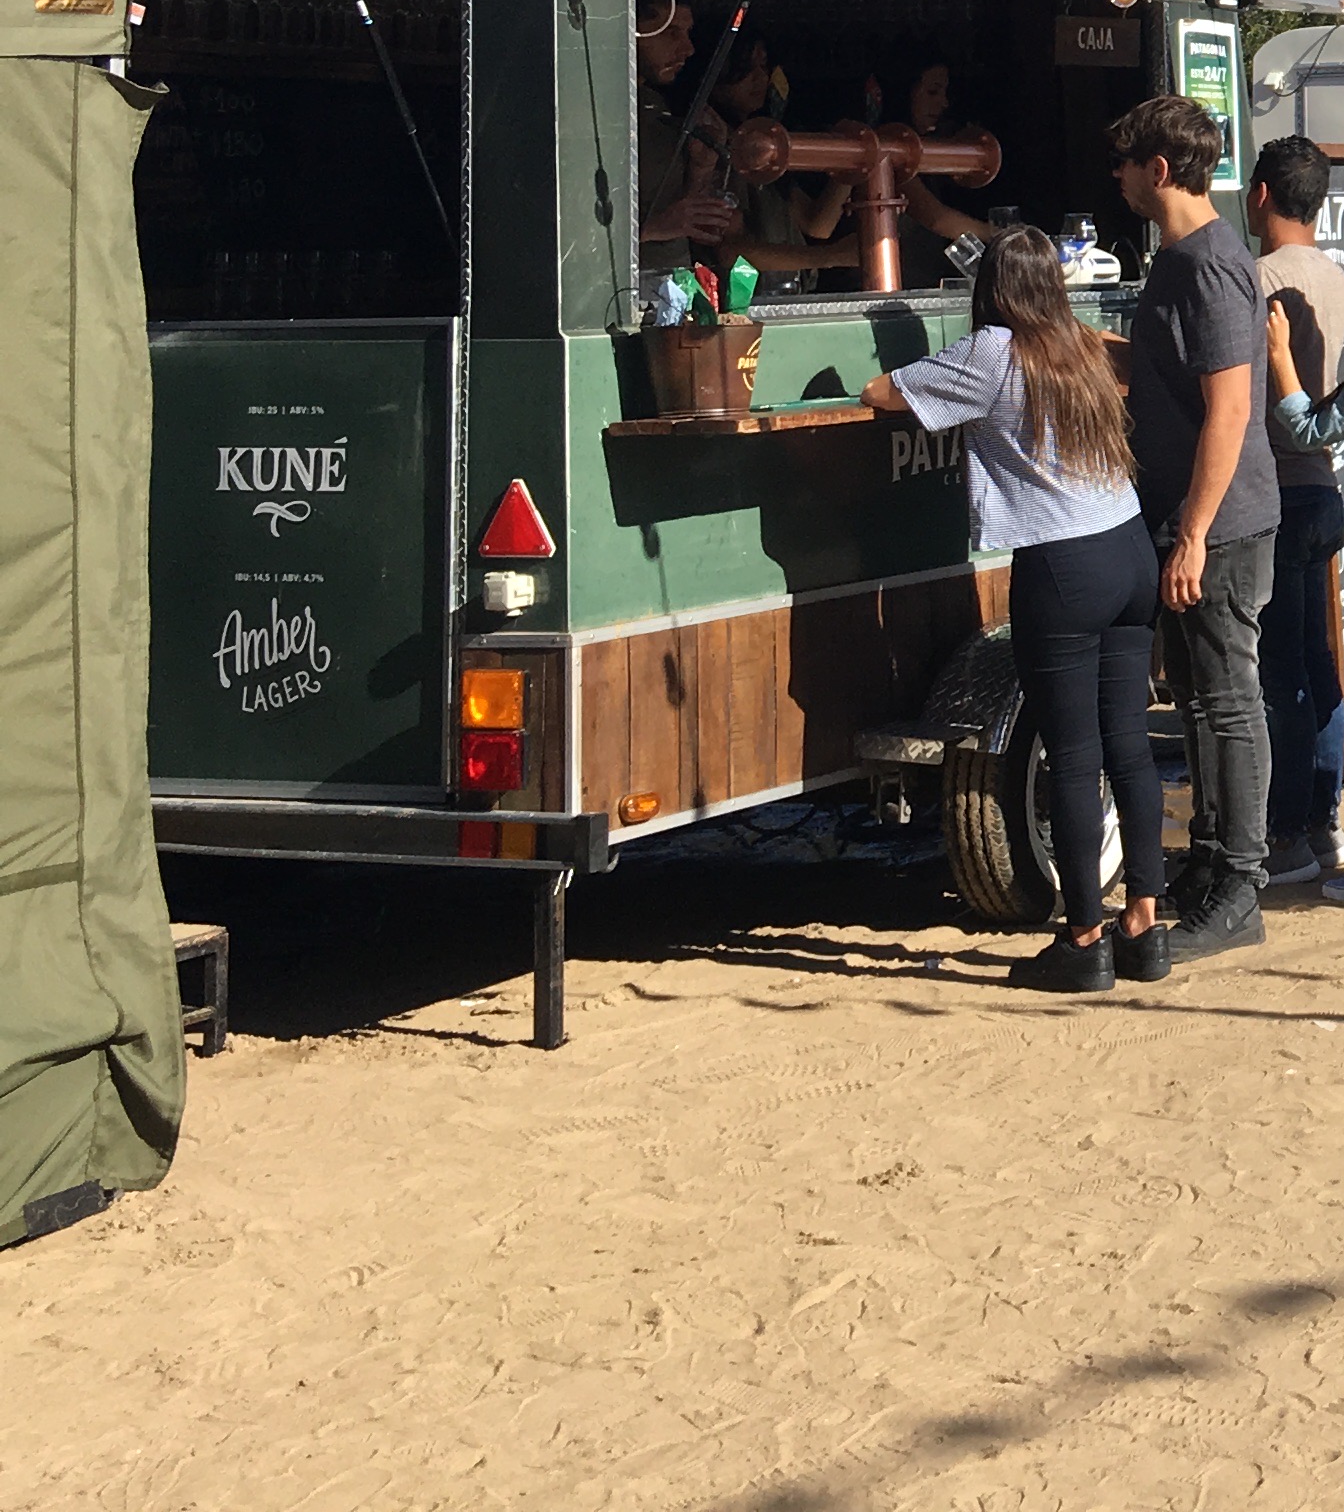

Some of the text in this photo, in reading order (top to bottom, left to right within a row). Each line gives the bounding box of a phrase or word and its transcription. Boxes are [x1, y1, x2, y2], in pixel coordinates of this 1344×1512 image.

[1077, 27, 1115, 51] CAJA
[267, 405, 278, 415] 25
[215, 436, 349, 492] KUNÉ
[234, 572, 250, 582] IBU:
[212, 596, 332, 689] Amber
[242, 670, 322, 713] LAGER
